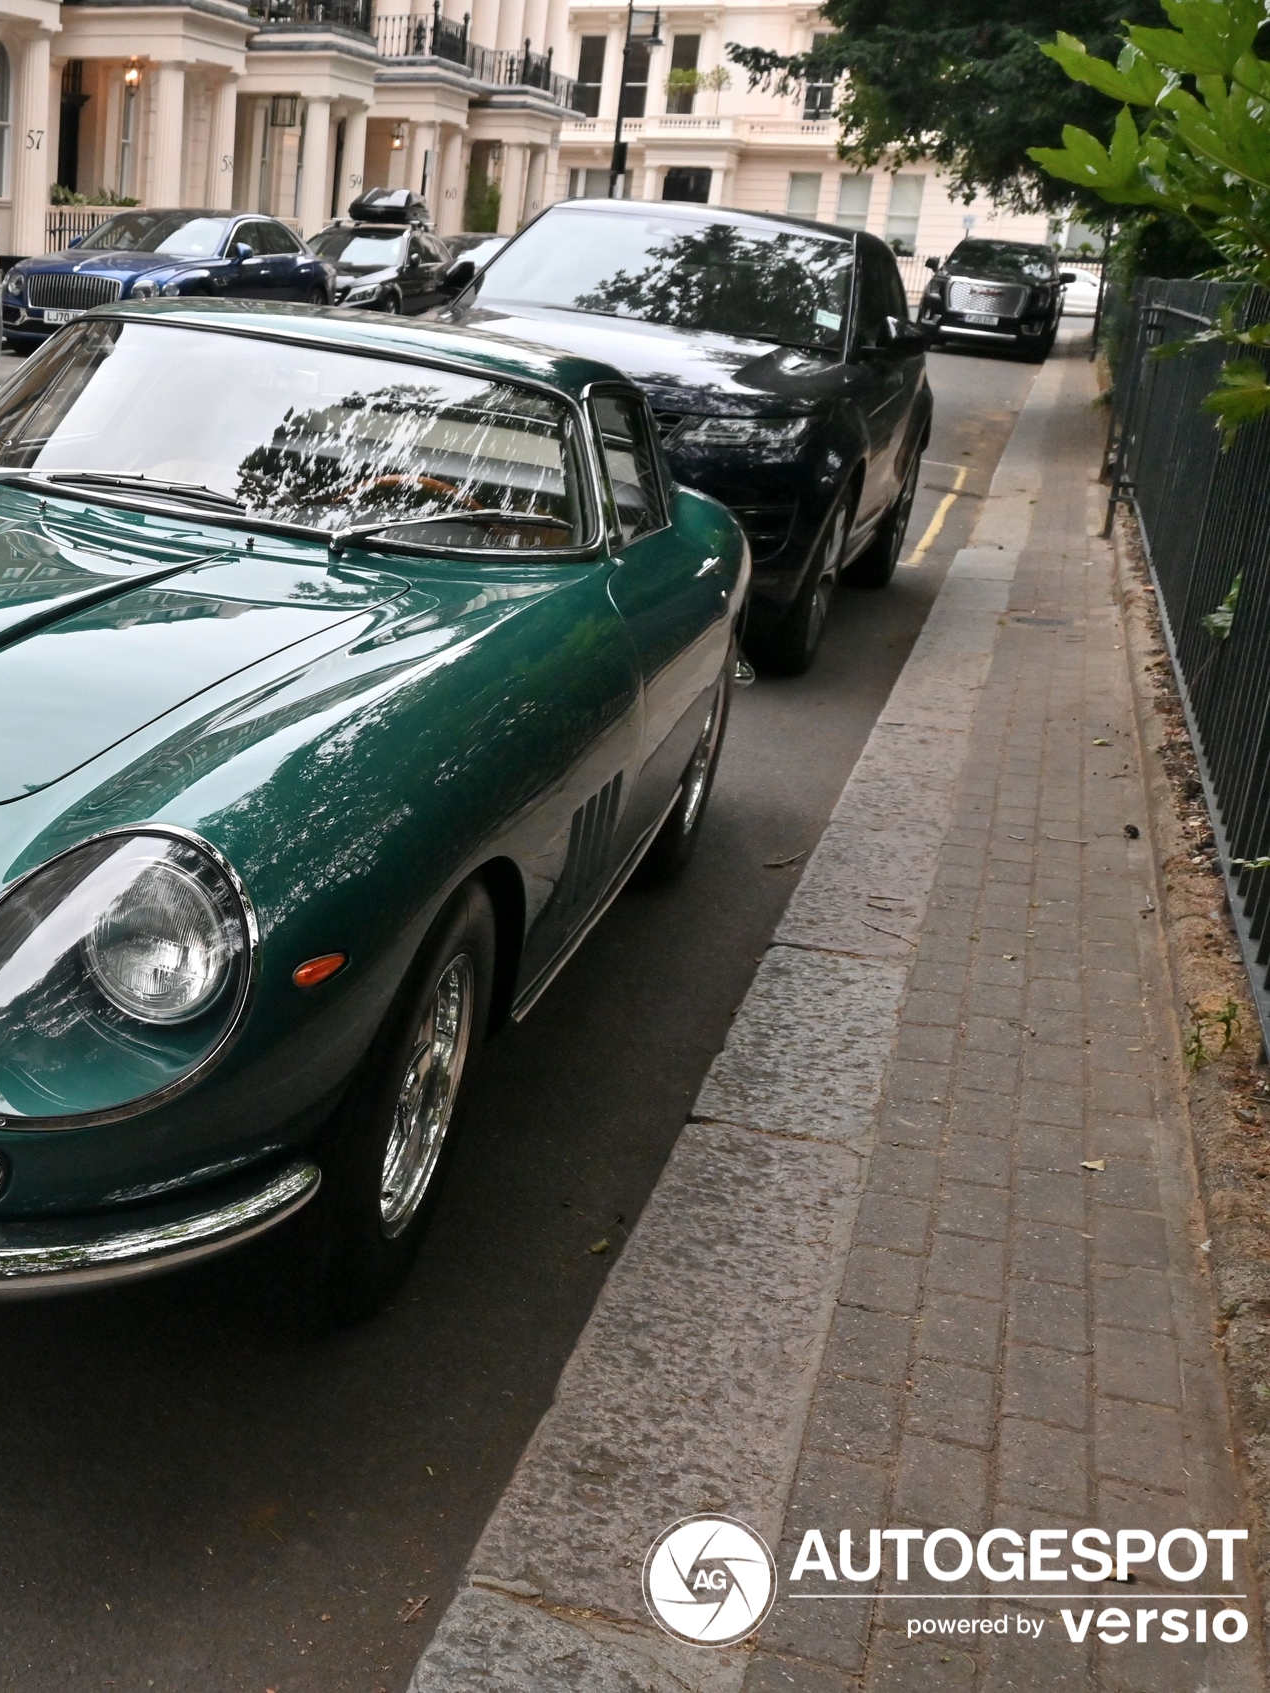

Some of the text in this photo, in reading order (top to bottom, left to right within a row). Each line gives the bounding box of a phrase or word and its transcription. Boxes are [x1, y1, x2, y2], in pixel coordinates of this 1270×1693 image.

[26, 130, 44, 150] 57
[349, 174, 362, 189] 59
[445, 187, 457, 199] 60
[47, 312, 70, 322] LJ70
